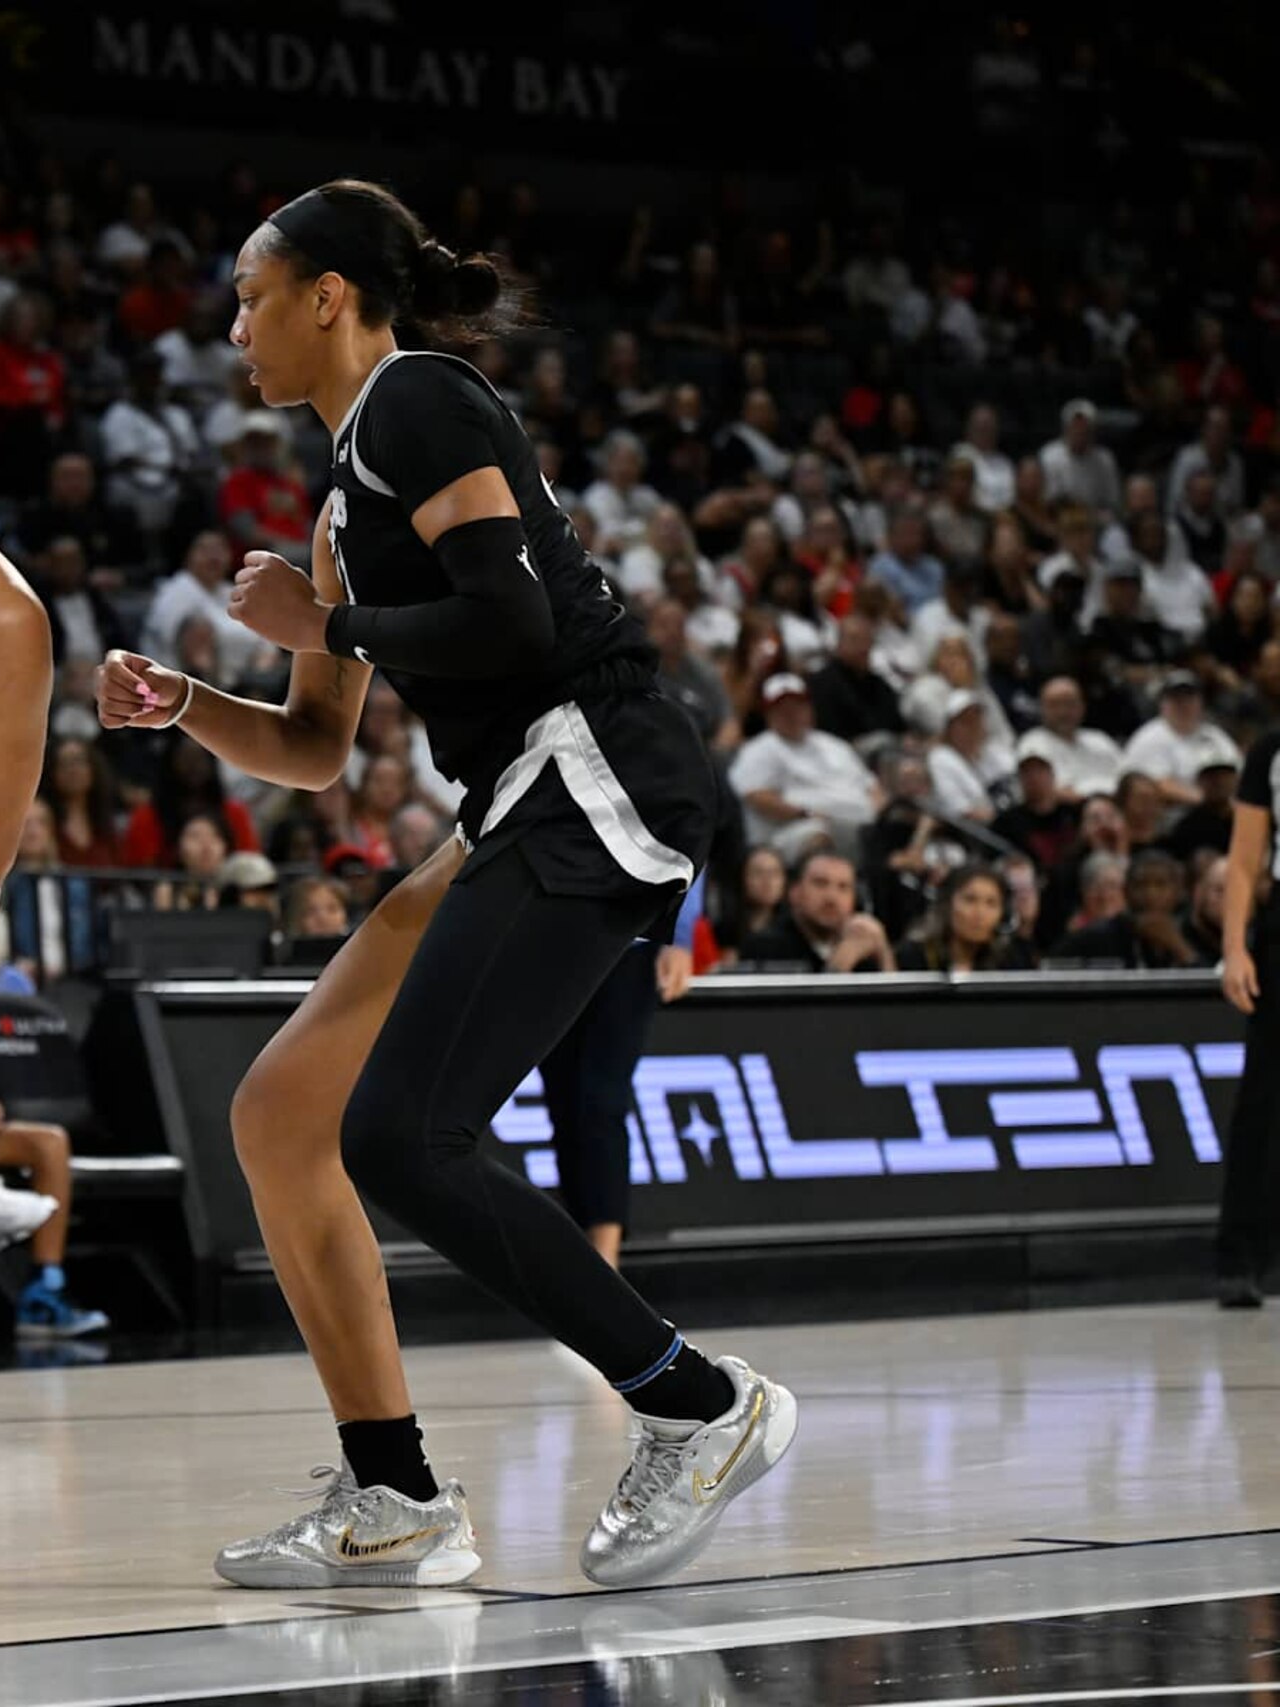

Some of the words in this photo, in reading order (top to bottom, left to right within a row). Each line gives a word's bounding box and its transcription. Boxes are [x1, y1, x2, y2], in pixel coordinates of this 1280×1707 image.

[92, 13, 490, 109] MANDALAY
[511, 55, 629, 122] BAY
[490, 1042, 1246, 1188] ALIEN
